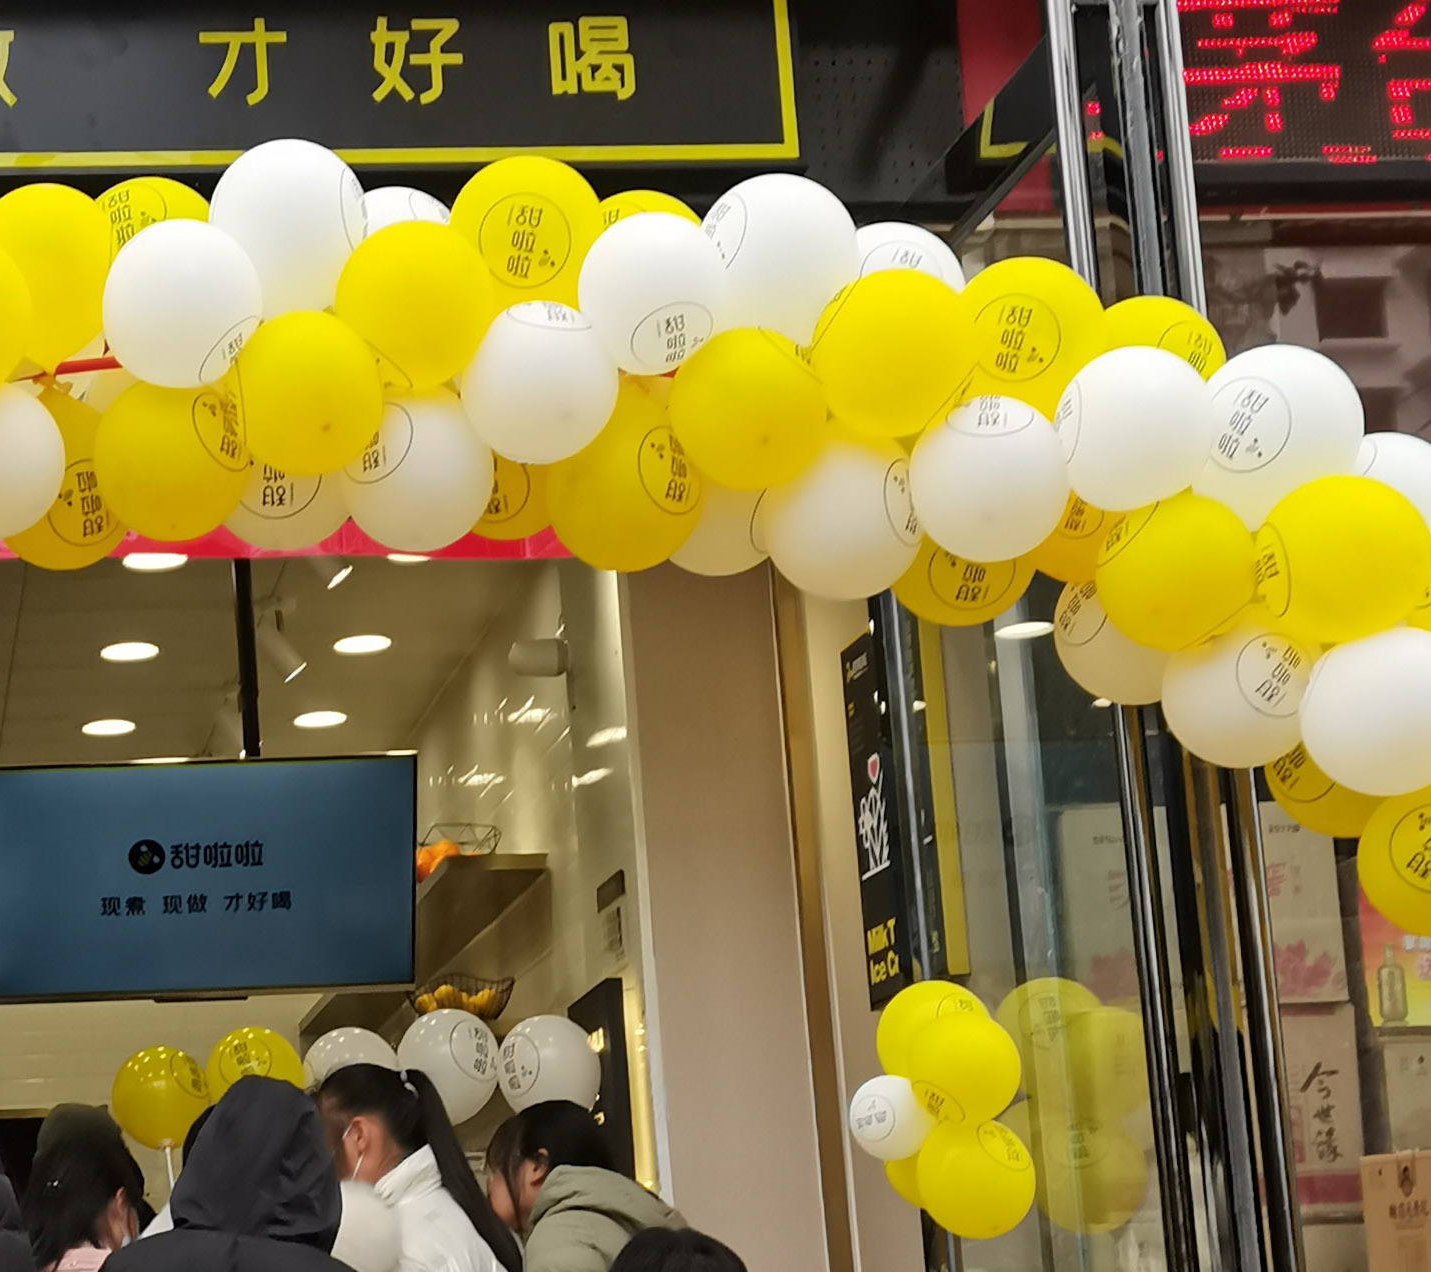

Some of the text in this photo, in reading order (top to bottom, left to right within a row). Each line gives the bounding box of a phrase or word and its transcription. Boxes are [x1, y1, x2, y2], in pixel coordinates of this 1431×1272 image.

[198, 15, 638, 106] 才好喝
[506, 205, 542, 278] 甜啦啦
[1218, 389, 1267, 459] 甜啦啦
[170, 840, 264, 869] 甜啦啦
[100, 890, 292, 917] 现煮 现做 才好喝
